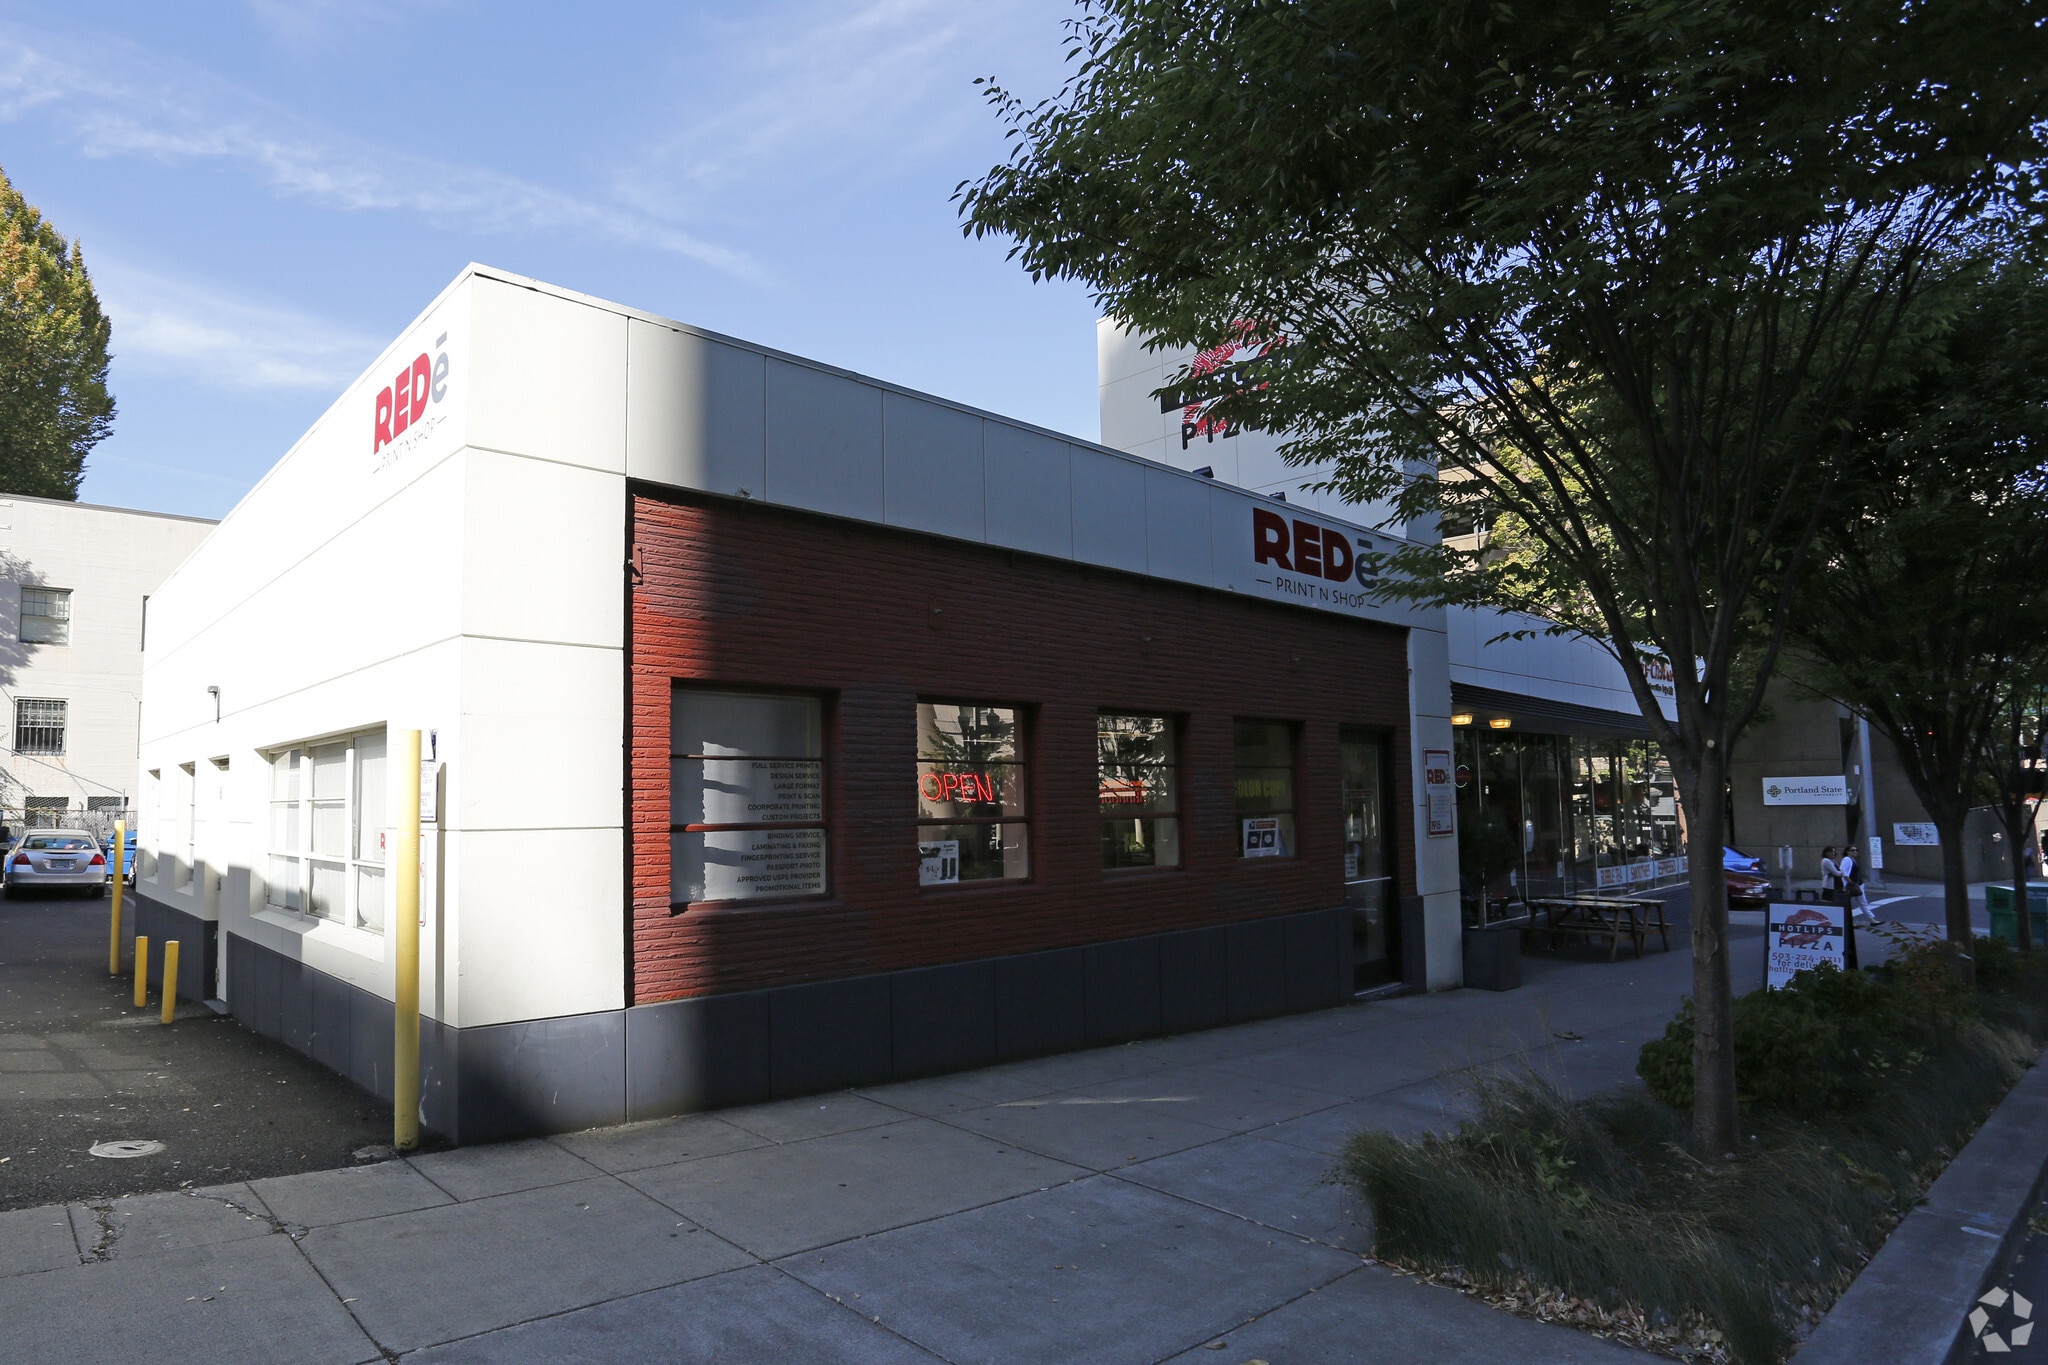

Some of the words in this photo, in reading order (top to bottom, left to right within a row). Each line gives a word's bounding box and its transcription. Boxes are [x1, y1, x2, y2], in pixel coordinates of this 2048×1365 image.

[1276, 577, 1316, 598] PRINT
[1319, 587, 1329, 600] N
[1333, 590, 1364, 608] SHOP
[920, 773, 993, 802] OPEN
[1784, 786, 1819, 794] Portland
[1821, 785, 1843, 793] State
[768, 832, 794, 840] BINDING
[752, 843, 793, 851] LAMINATING
[741, 854, 794, 862] FINGERPRINTING
[737, 875, 771, 884] APPROVED
[756, 884, 801, 893] PROMOTIONAL
[1778, 924, 1833, 935] HOTLIPS
[1779, 938, 1833, 952] PIZZA
